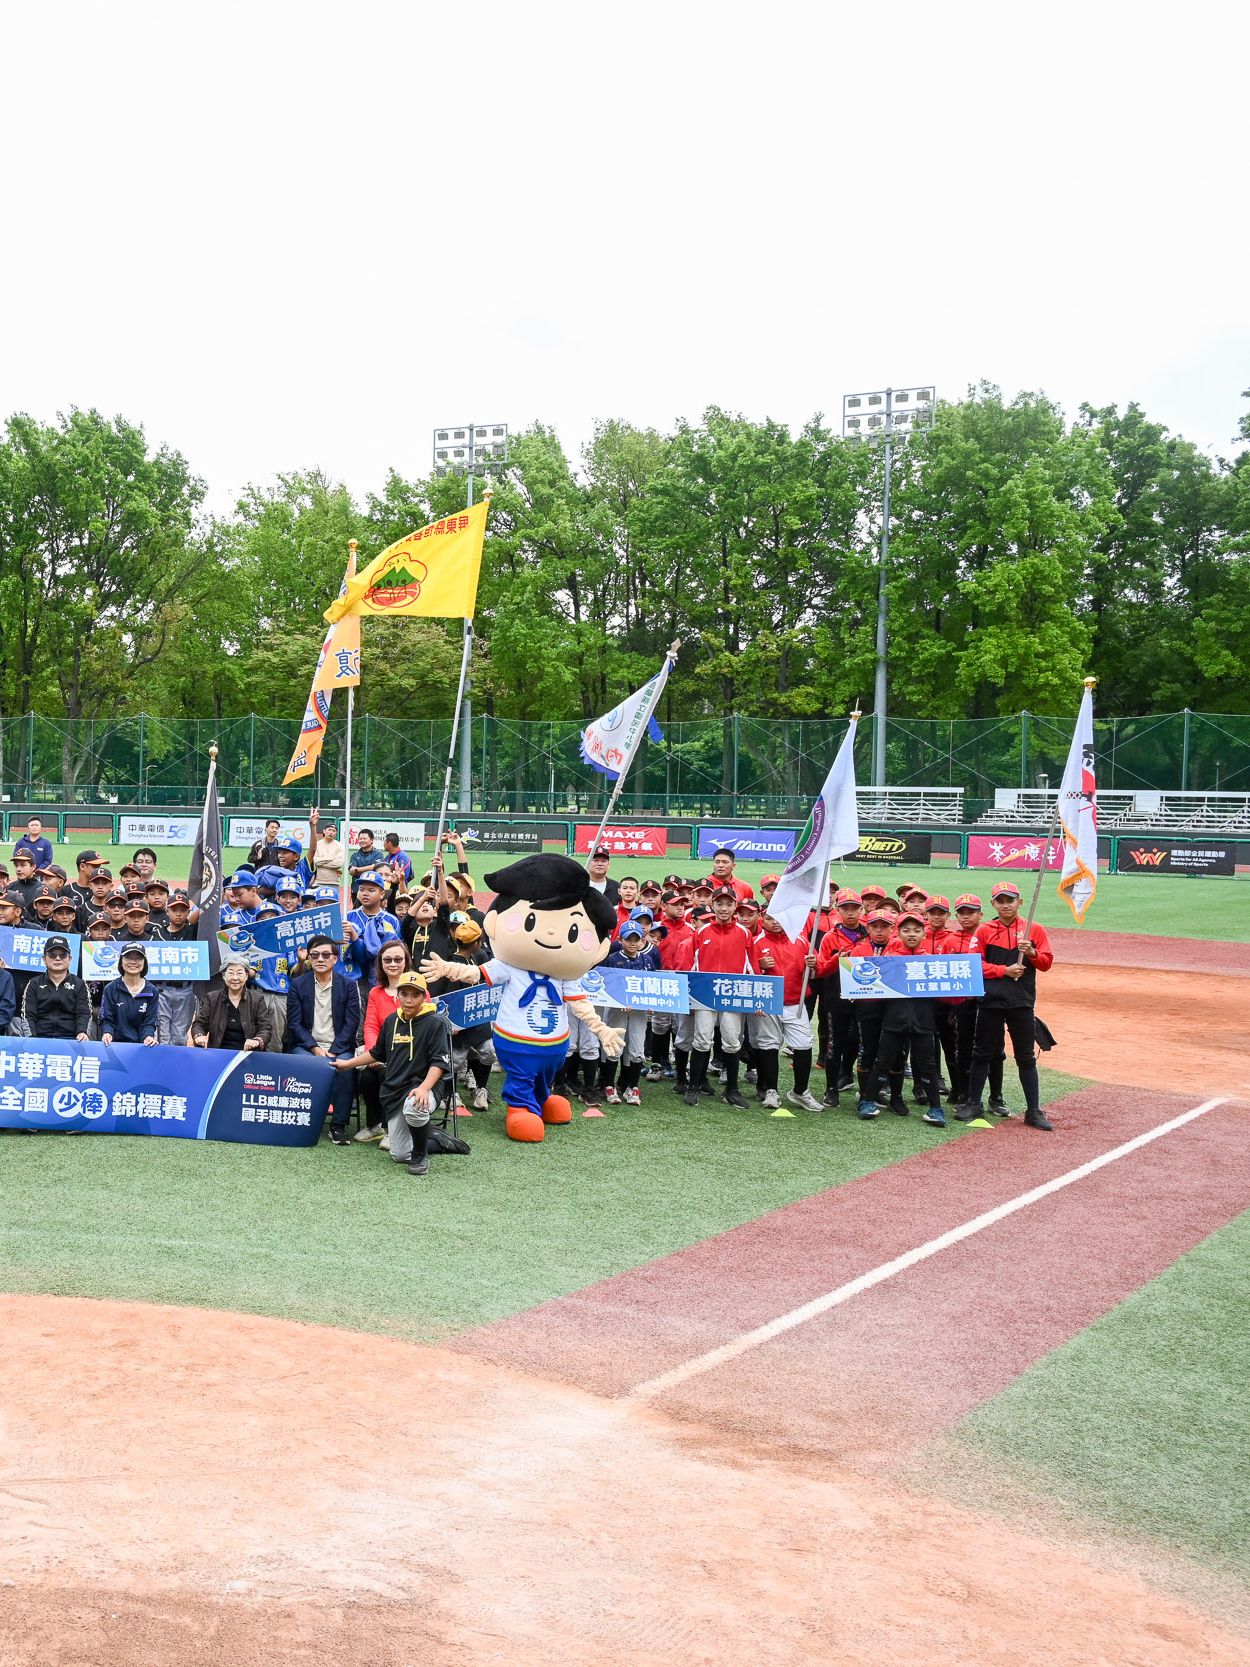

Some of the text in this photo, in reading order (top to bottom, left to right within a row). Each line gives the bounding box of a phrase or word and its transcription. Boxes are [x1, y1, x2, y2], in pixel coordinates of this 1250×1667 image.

[128, 824, 187, 838] 中華電信 5G
[483, 832, 537, 840] 臺北市政府體育局
[732, 837, 786, 851] MIZUNO
[42, 887, 49, 896] S
[133, 900, 141, 908] C
[275, 912, 332, 940] 高雄市
[905, 960, 972, 981] 臺東縣
[625, 975, 681, 997] 宜蘭縣
[713, 978, 774, 999] 花蓮縣
[915, 982, 964, 992] 紅葉國小
[721, 998, 765, 1009] 中原國小
[253, 1079, 276, 1087] League
[290, 1086, 312, 1095] Taipei
[242, 1094, 312, 1110] LLB威廉波特
[241, 1108, 311, 1126] 國手選拔賽
